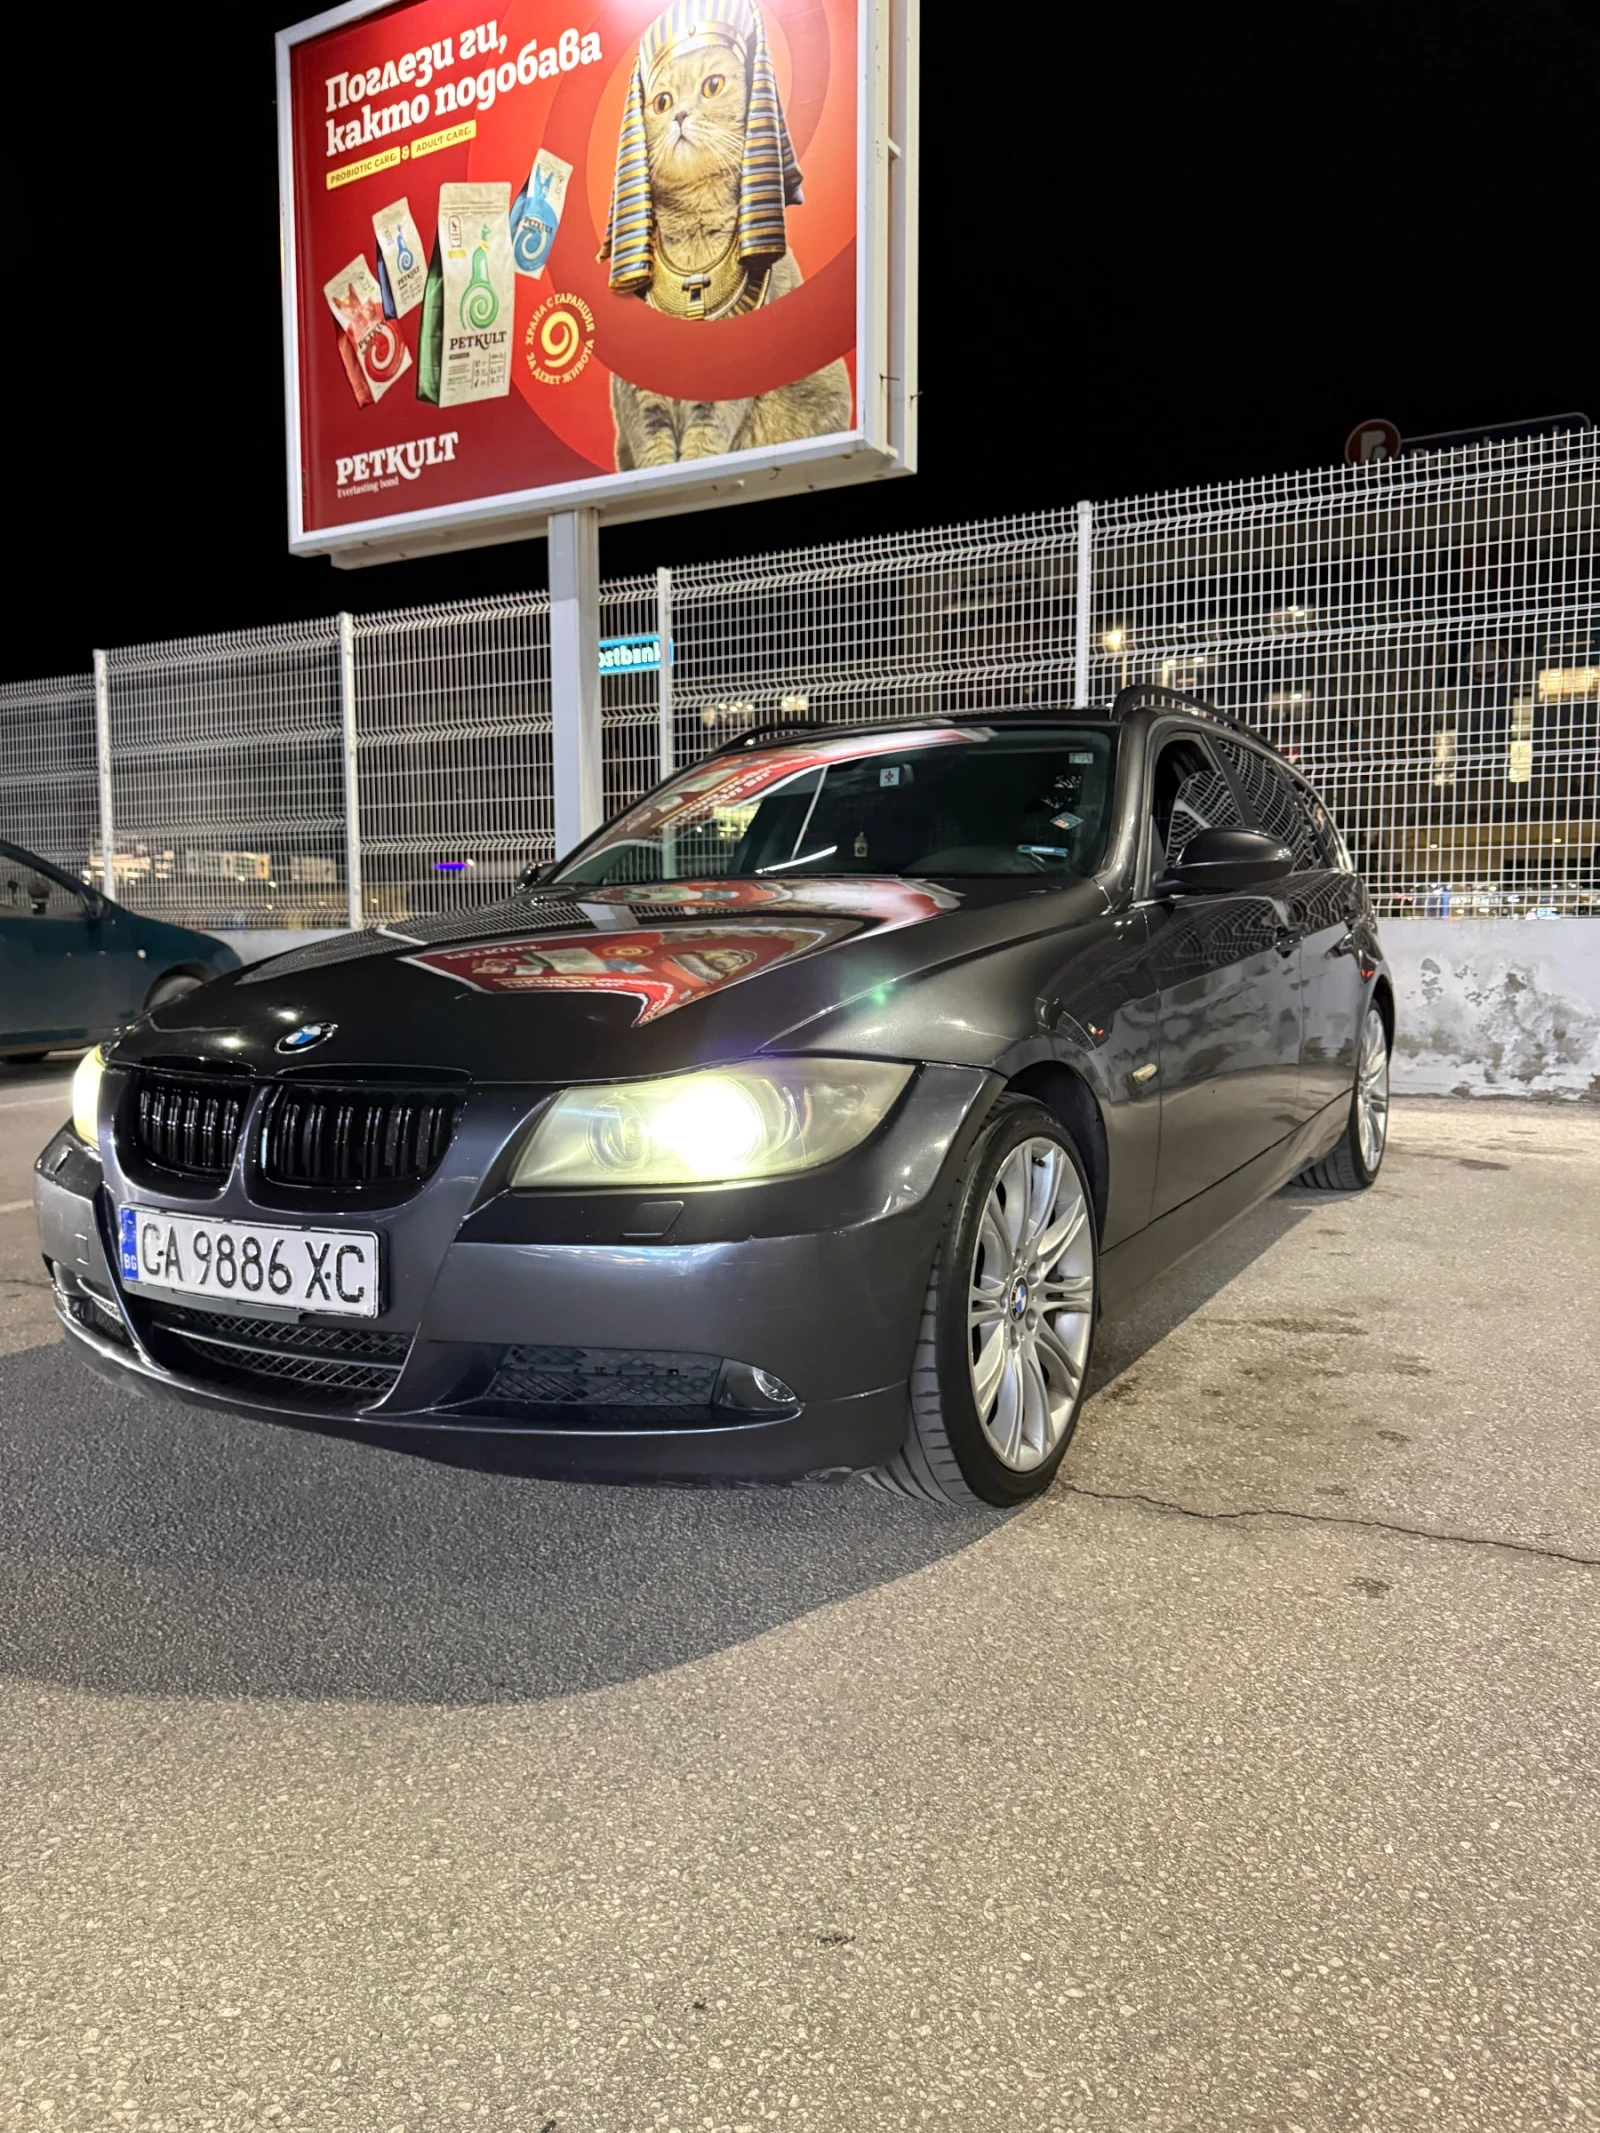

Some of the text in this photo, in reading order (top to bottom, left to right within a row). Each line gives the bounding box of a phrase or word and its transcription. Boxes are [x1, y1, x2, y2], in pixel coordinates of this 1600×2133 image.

[325, 19, 508, 113] Поглези ги,
[325, 27, 603, 157] както подобава
[330, 161, 372, 185] PROBIOTIC
[374, 153, 397, 168] CARE
[416, 136, 444, 153] ADULT
[446, 126, 471, 142] CARE
[449, 331, 507, 350] PETKULT
[525, 304, 547, 345] ХРАНА
[554, 292, 595, 332] ГАРАНЦИЯ
[526, 339, 594, 385] ЗА ДЕВЕТ ЖИВОТА
[335, 431, 459, 486] PETKULT
[337, 481, 379, 498] Everlasting
[123, 1252, 137, 1271] BG
[193, 1230, 292, 1295] 9886
[304, 1241, 365, 1304] XC
